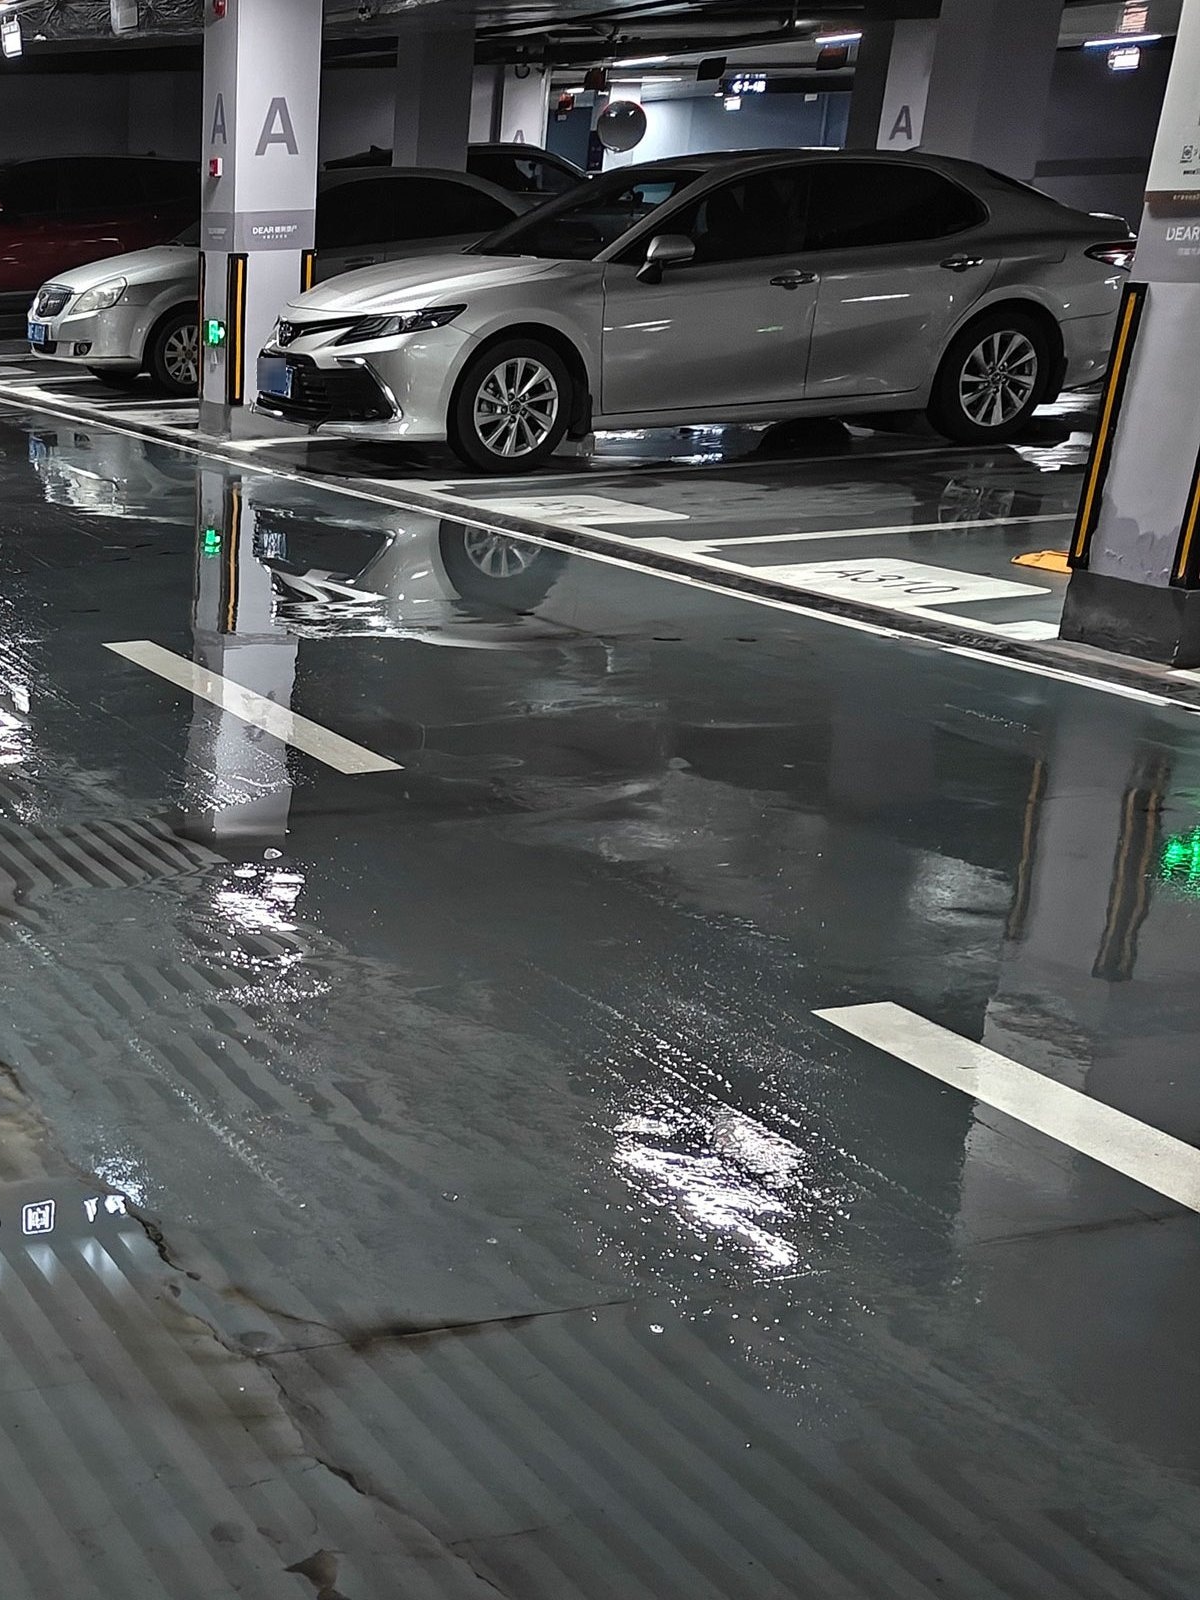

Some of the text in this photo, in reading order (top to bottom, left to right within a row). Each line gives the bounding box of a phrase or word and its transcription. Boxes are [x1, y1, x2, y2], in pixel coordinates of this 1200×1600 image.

[211, 92, 227, 144] A
[255, 97, 299, 156] A
[889, 105, 912, 140] A
[252, 226, 274, 235] DEAR
[1165, 226, 1200, 241] DEAR
[814, 569, 960, 594] A310
